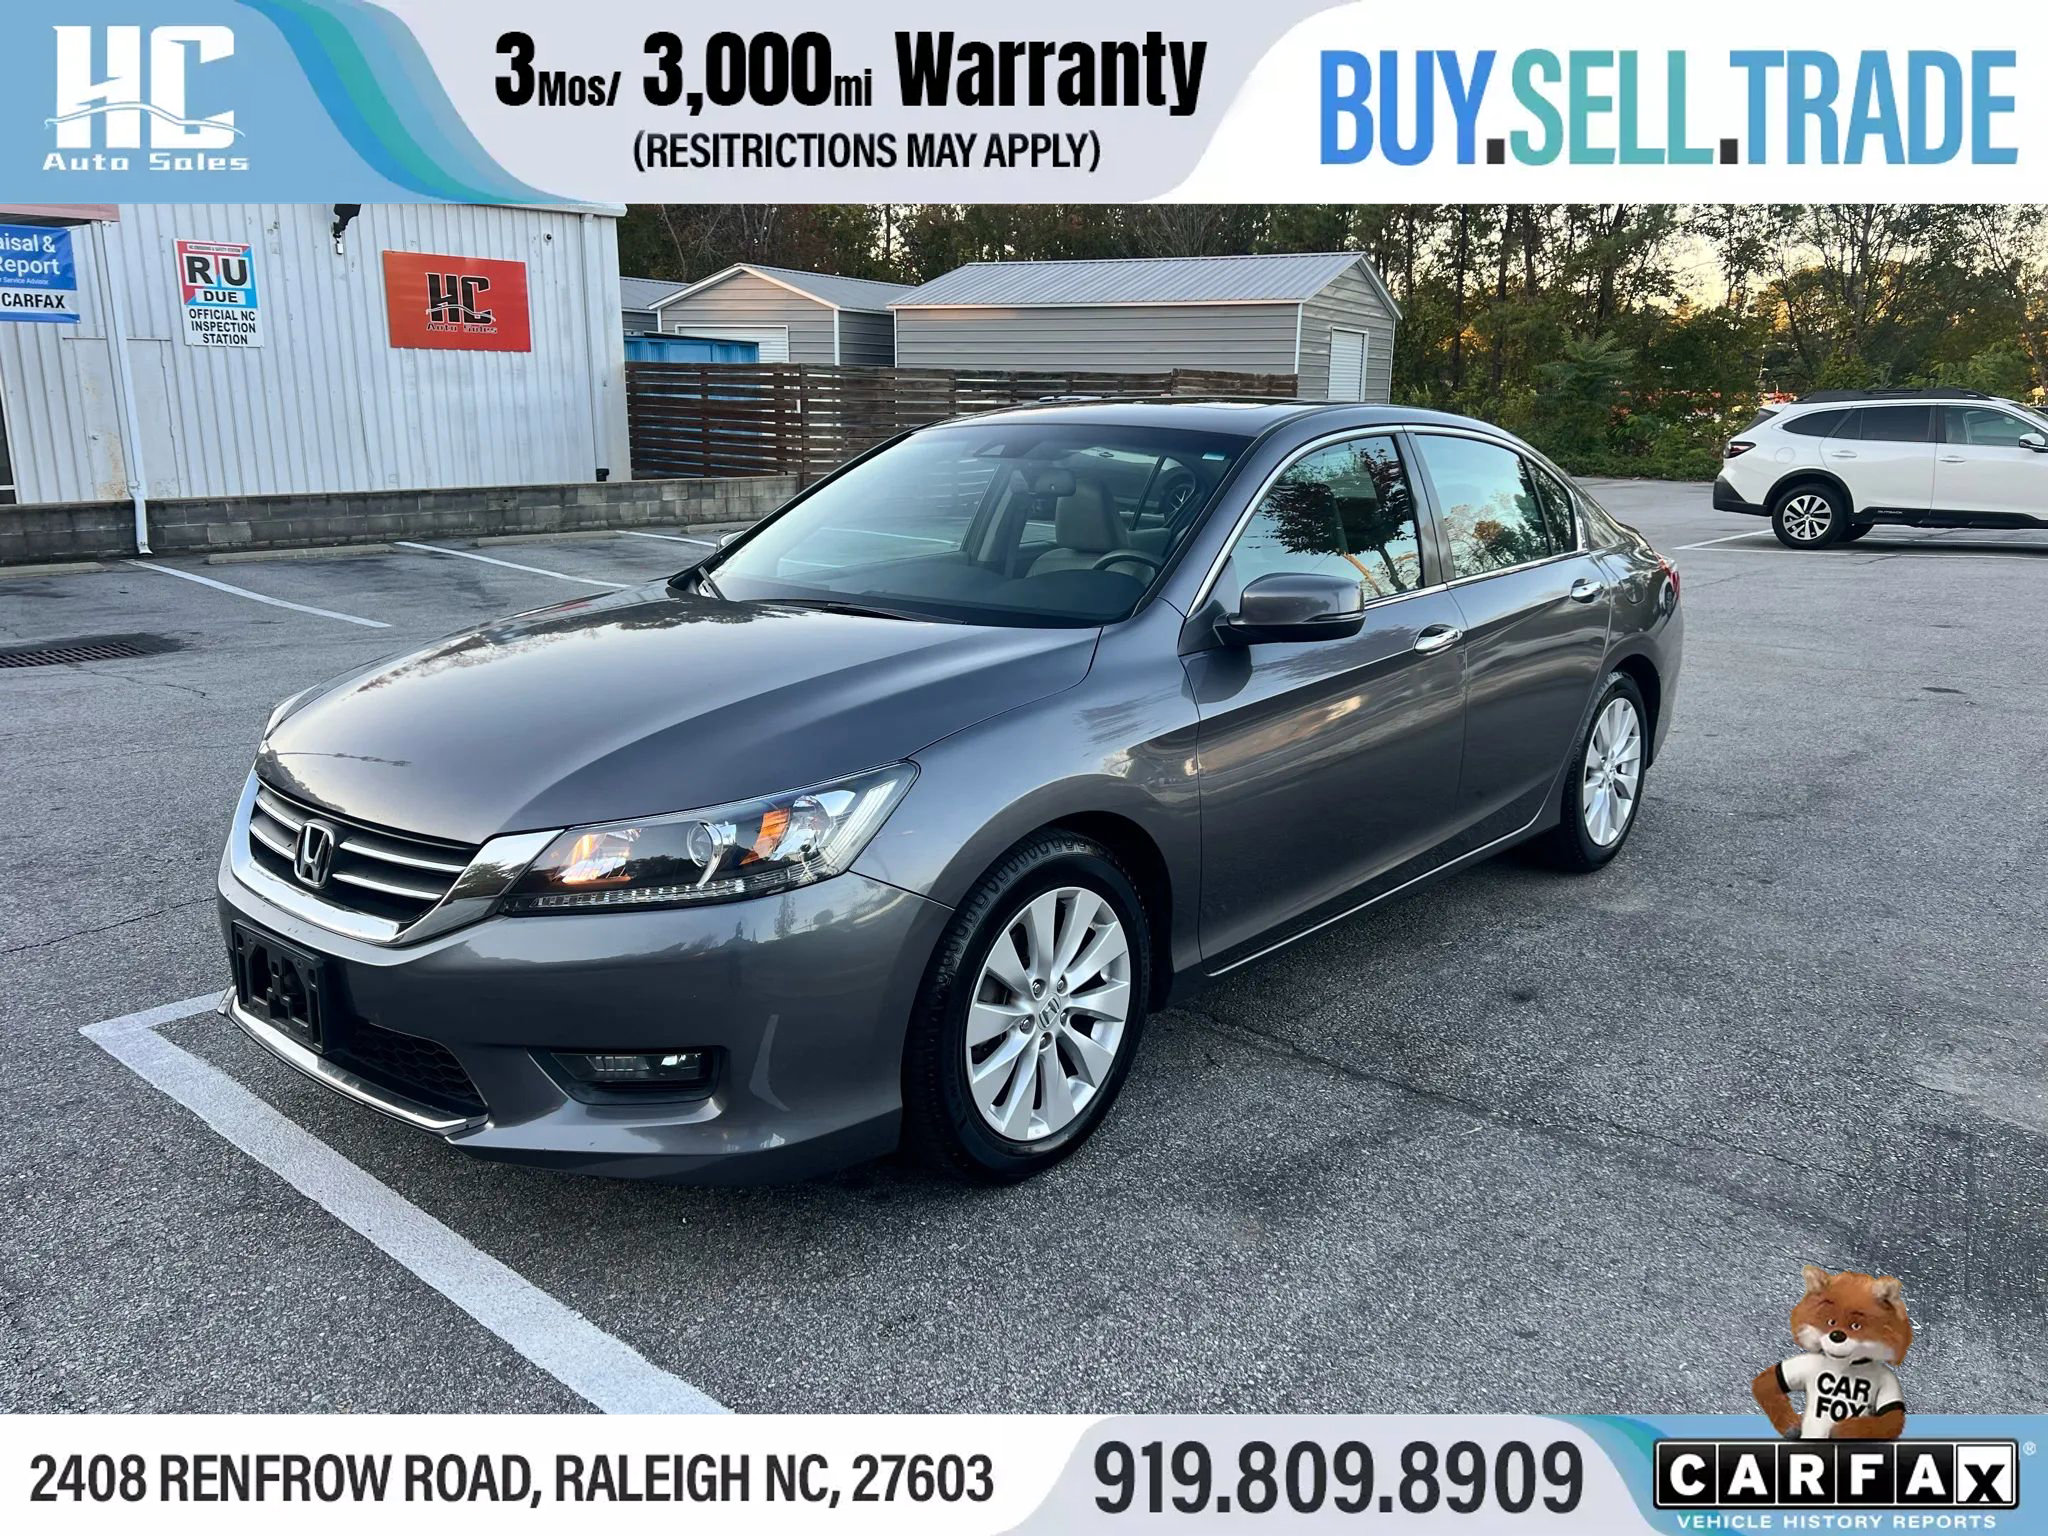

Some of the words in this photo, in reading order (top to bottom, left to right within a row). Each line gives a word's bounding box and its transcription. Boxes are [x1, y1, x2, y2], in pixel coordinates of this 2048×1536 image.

[43, 235, 56, 253] &
[1, 292, 66, 309] CARFAX
[203, 290, 238, 303] DUE
[425, 272, 492, 325] HC
[188, 308, 238, 321] OFFICIAL
[240, 310, 256, 322] NC
[191, 320, 257, 334] INSPECTION
[202, 333, 249, 345] STATION
